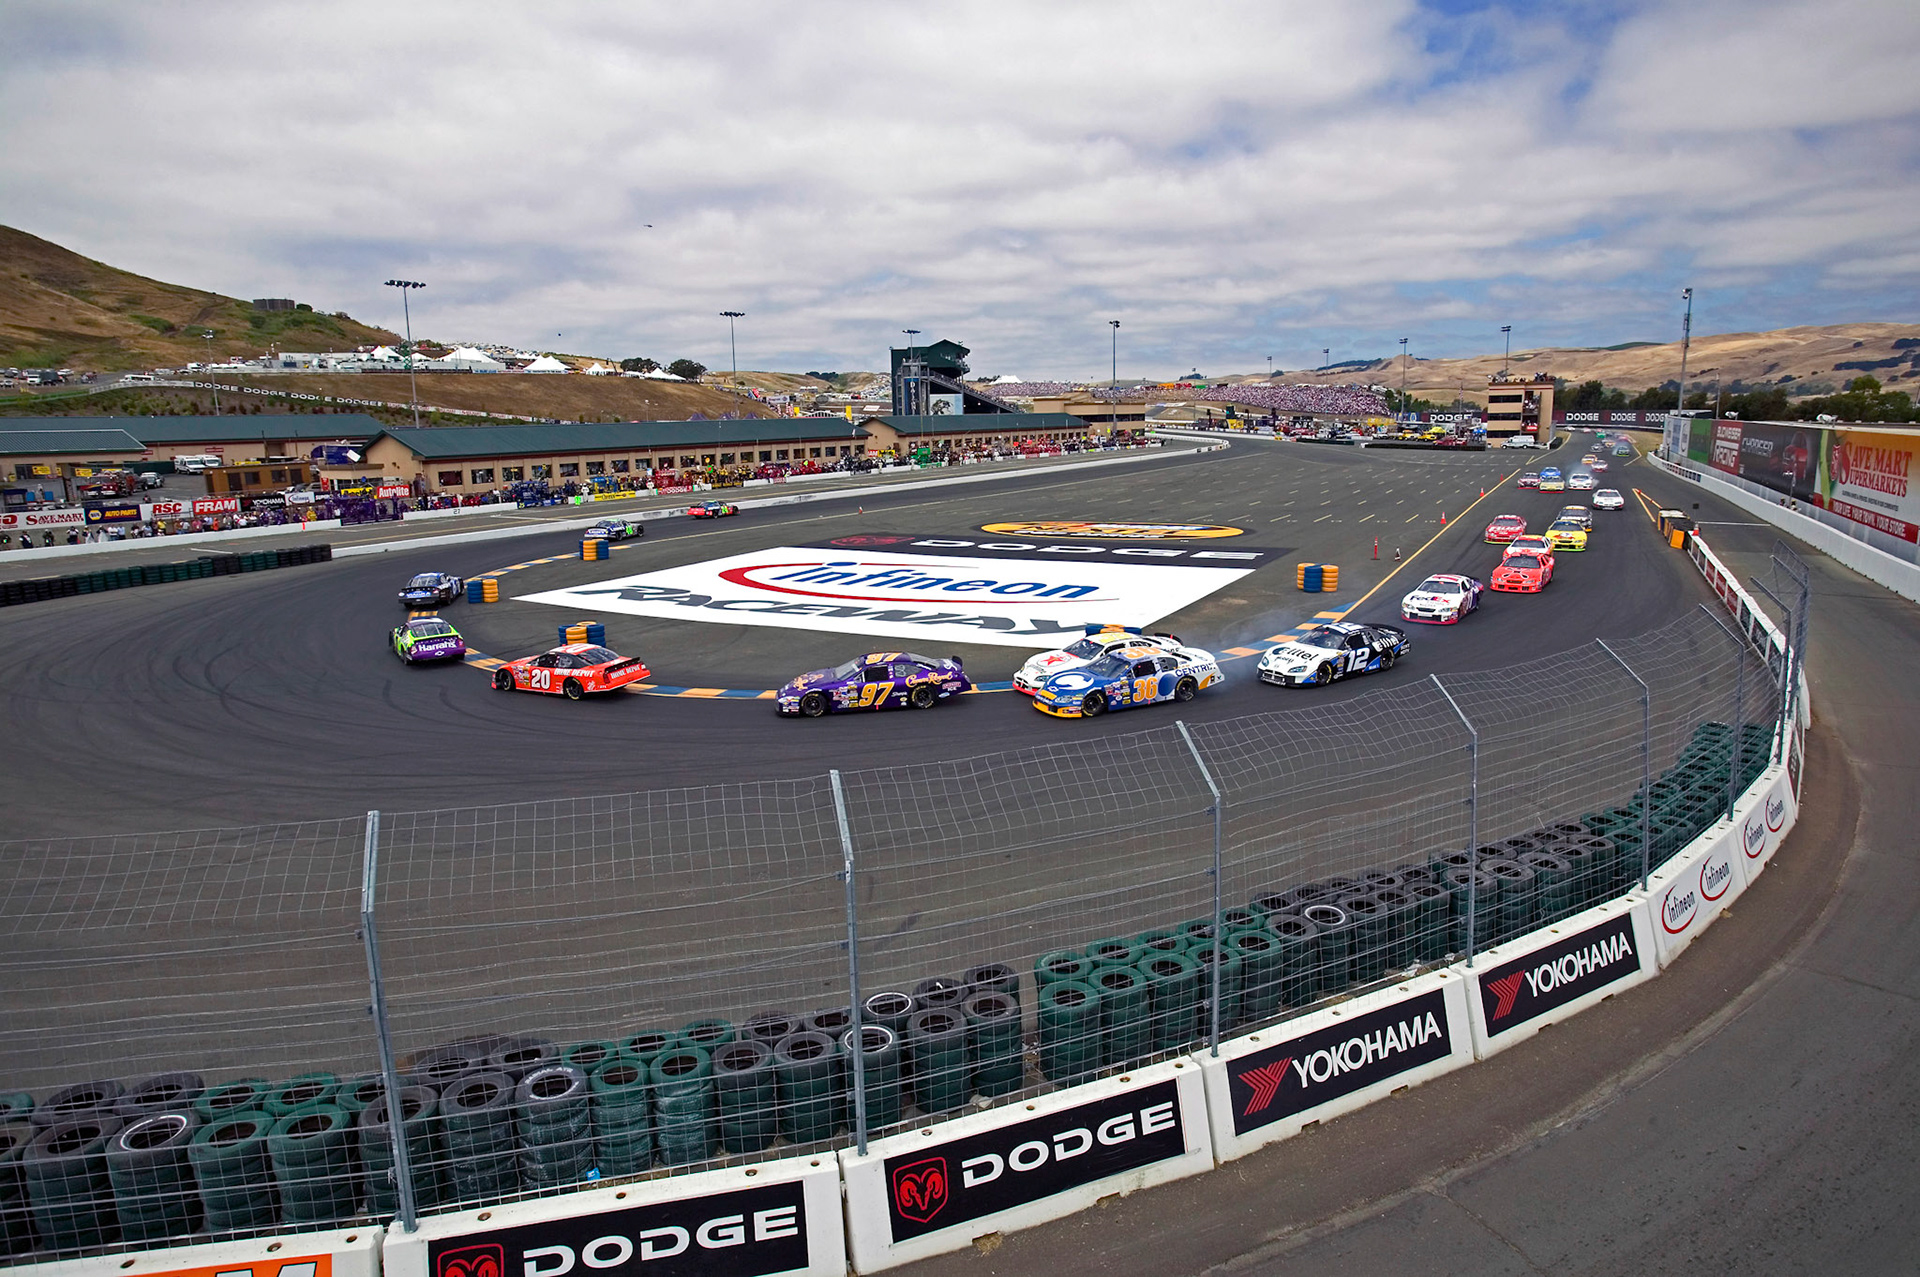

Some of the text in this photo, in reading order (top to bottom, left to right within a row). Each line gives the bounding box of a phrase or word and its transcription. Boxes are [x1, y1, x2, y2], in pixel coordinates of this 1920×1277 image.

[1566, 412, 1600, 421] DODGE
[1611, 412, 1637, 422] DODGE
[1873, 447, 1913, 478] MART
[152, 502, 182, 514] RSC
[194, 499, 236, 515] FRAM
[252, 497, 285, 507] YOKOHAMA
[60, 512, 84, 520] MART
[104, 508, 138, 518] AUTO PARTS
[910, 539, 1264, 560] DODGE
[567, 585, 1103, 637] RACEWAY
[865, 653, 902, 664] 97
[1346, 647, 1370, 673] 12
[531, 668, 551, 690] 20
[554, 668, 595, 678] HOME DEPOT
[611, 665, 641, 679] HOME DEPOT
[859, 682, 895, 707] 97
[1133, 677, 1159, 703] 36
[1524, 931, 1633, 998] YOKOHAMA
[1292, 1011, 1442, 1088] YOKOHAMA
[961, 1101, 1176, 1189] DODGE
[523, 1205, 799, 1277] DODGE
